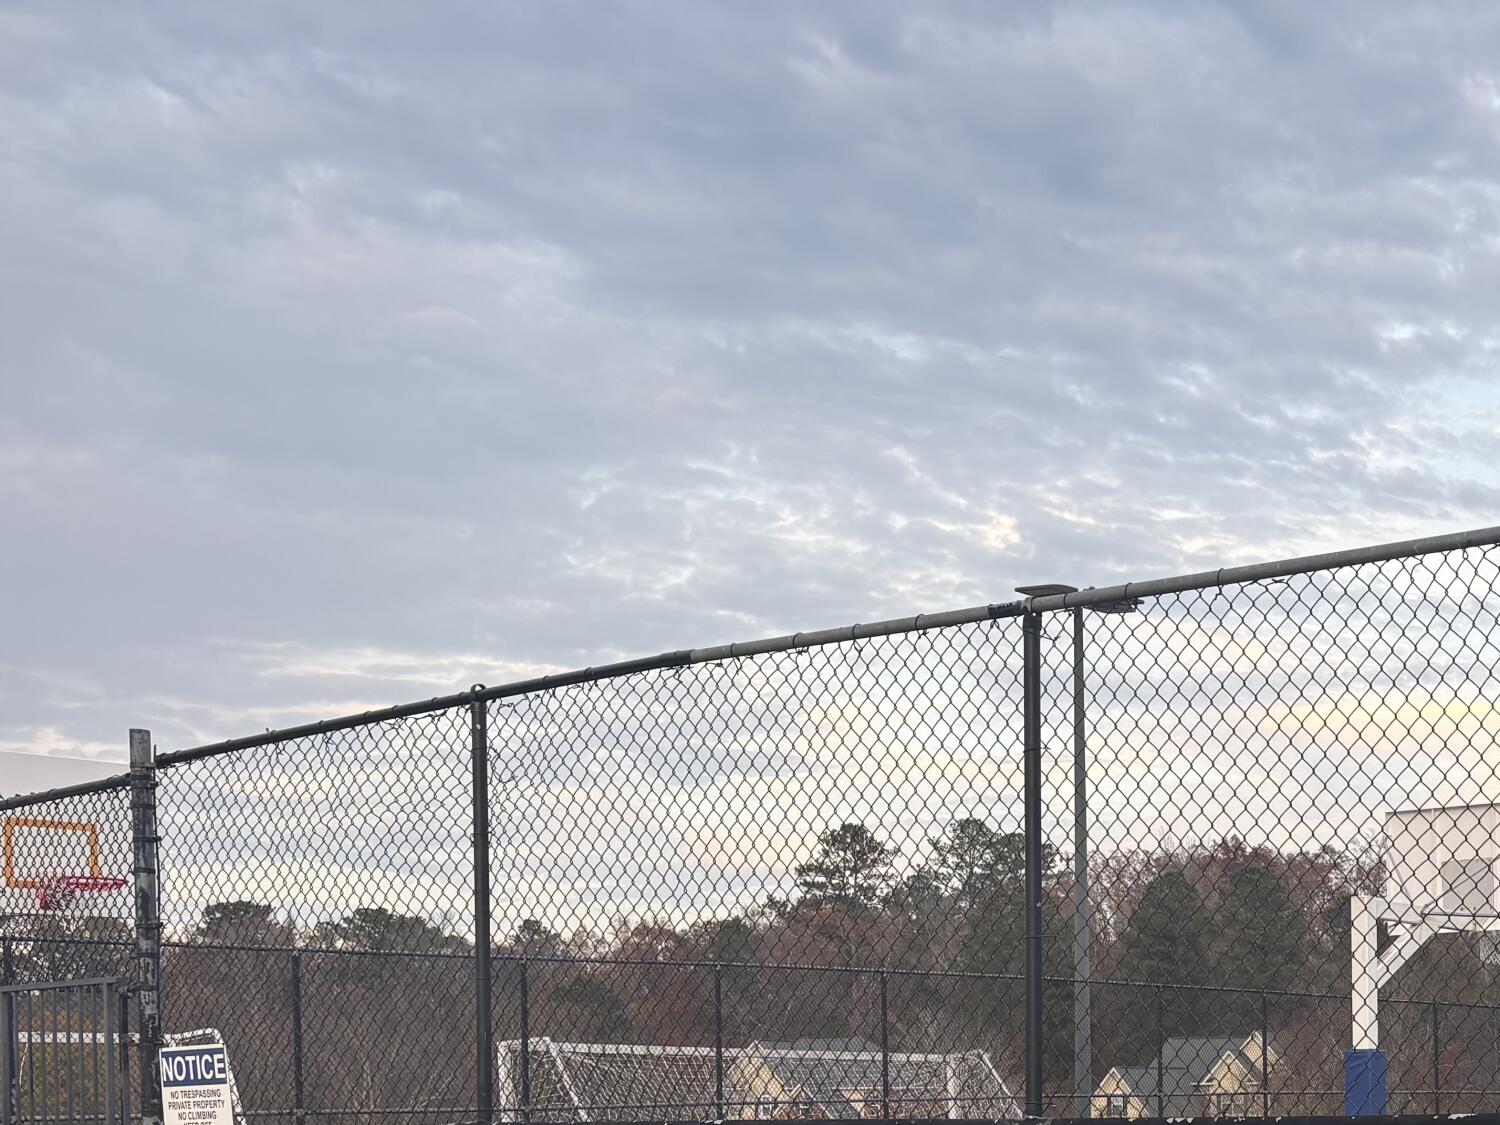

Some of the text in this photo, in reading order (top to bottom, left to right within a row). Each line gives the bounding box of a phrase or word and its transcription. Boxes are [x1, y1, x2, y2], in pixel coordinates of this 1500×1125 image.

[162, 1054, 226, 1082] NOTICE
[170, 1089, 221, 1100] NO TRESPASSING
[168, 1099, 225, 1111] PRIVATE PROPERTY
[178, 1111, 217, 1121] NO CLIMBING
